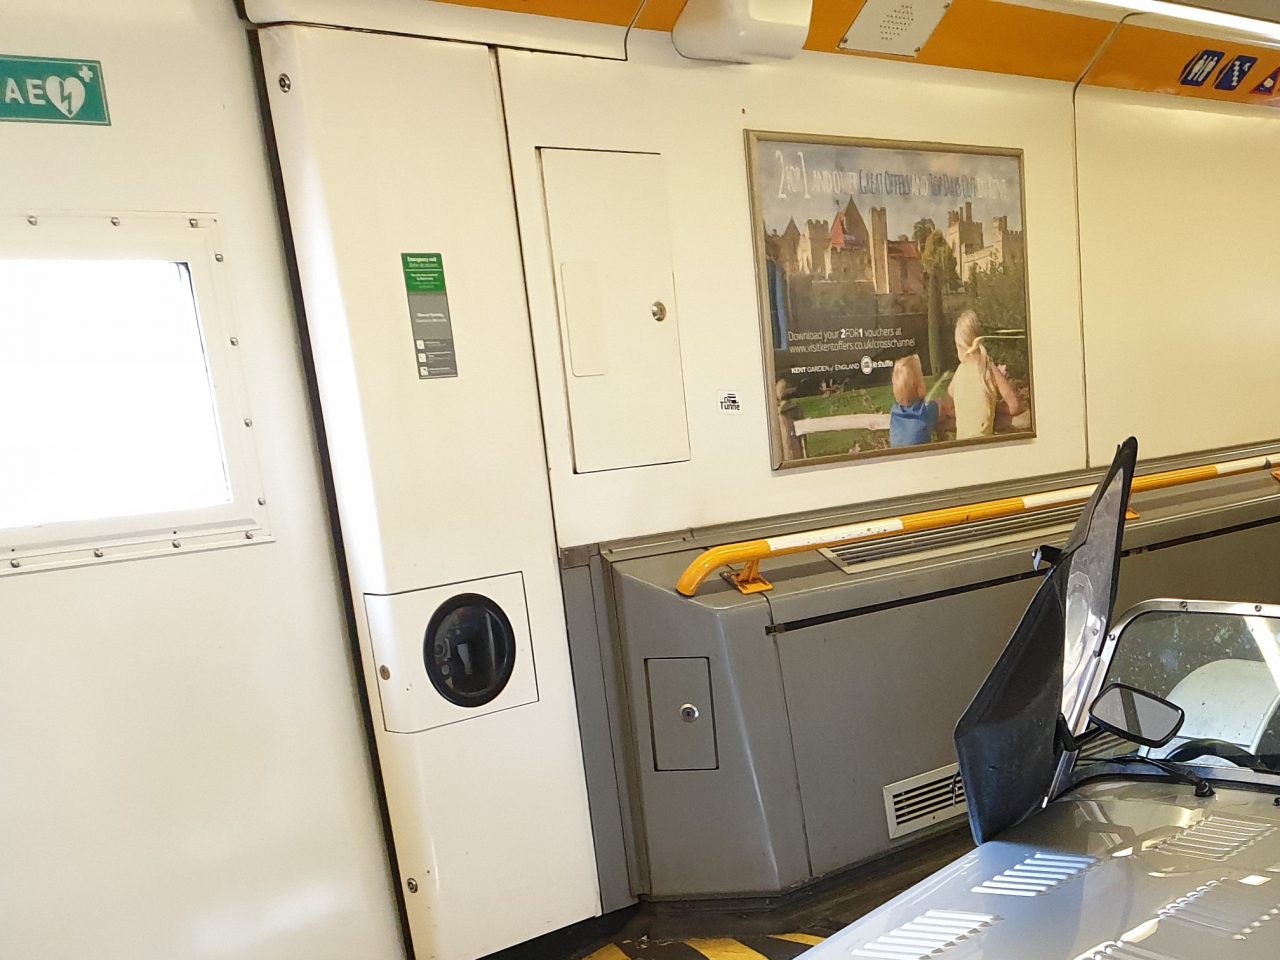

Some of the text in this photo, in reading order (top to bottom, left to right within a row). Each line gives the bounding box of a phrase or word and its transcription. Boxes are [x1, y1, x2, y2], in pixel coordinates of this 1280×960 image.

[788, 327, 902, 343] Download your 2FOR1 vouchers at
[835, 362, 860, 371] ENGLAND
